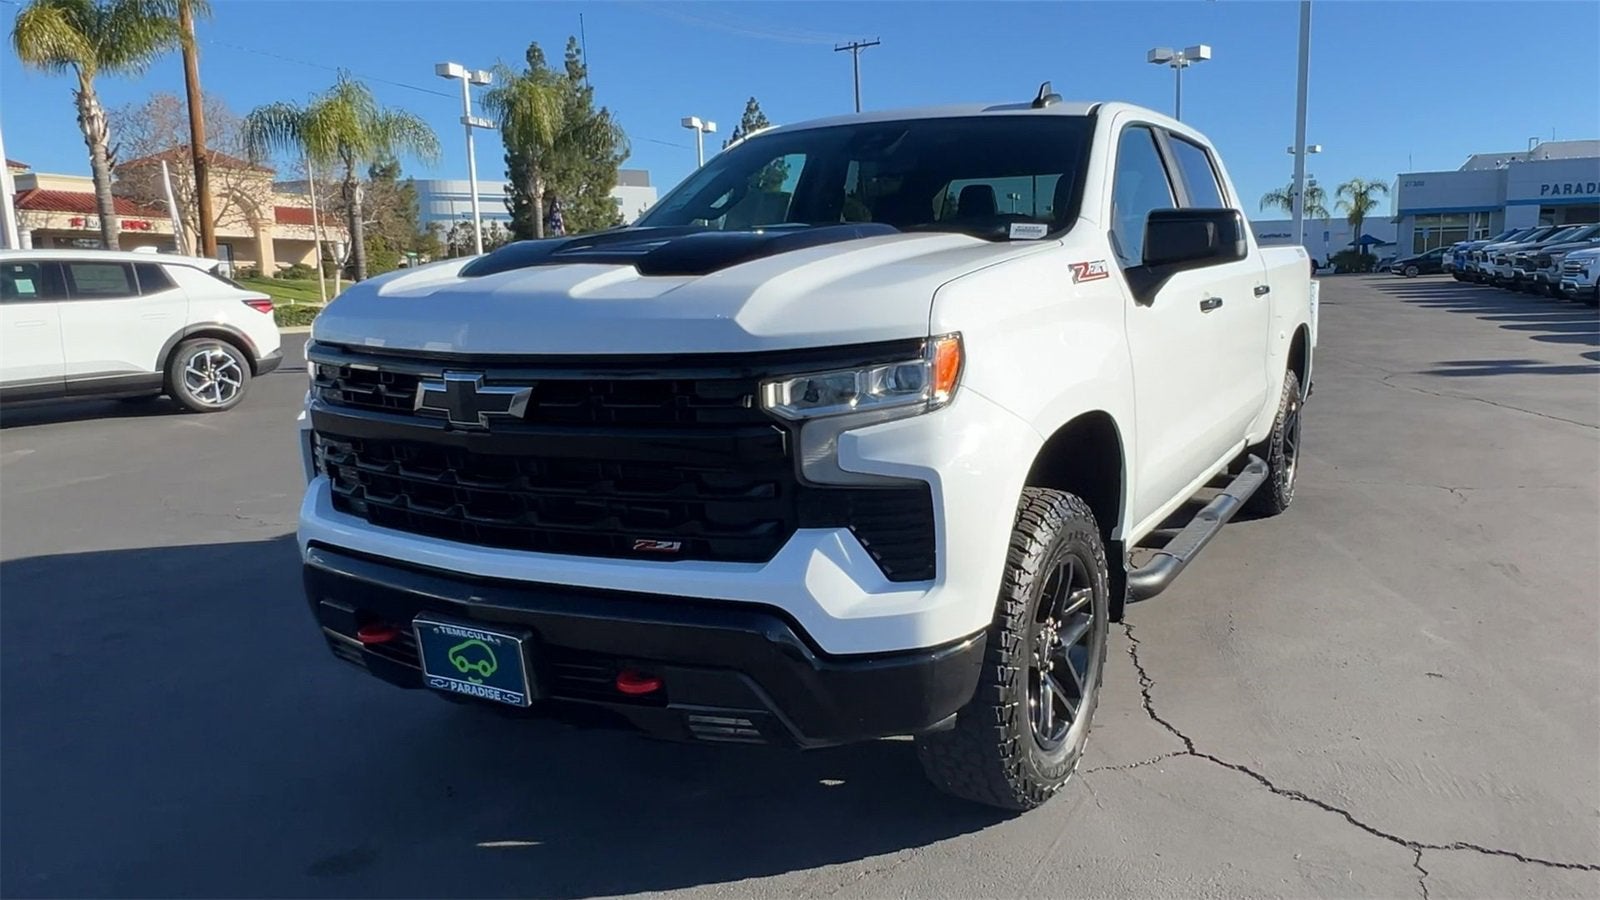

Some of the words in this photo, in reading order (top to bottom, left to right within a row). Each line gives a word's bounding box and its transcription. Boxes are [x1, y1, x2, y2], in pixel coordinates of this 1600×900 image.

[1068, 260, 1110, 285] Z71
[633, 539, 682, 553] Z71
[439, 626, 495, 642] TEMECULA
[450, 681, 502, 701] PARADISE
